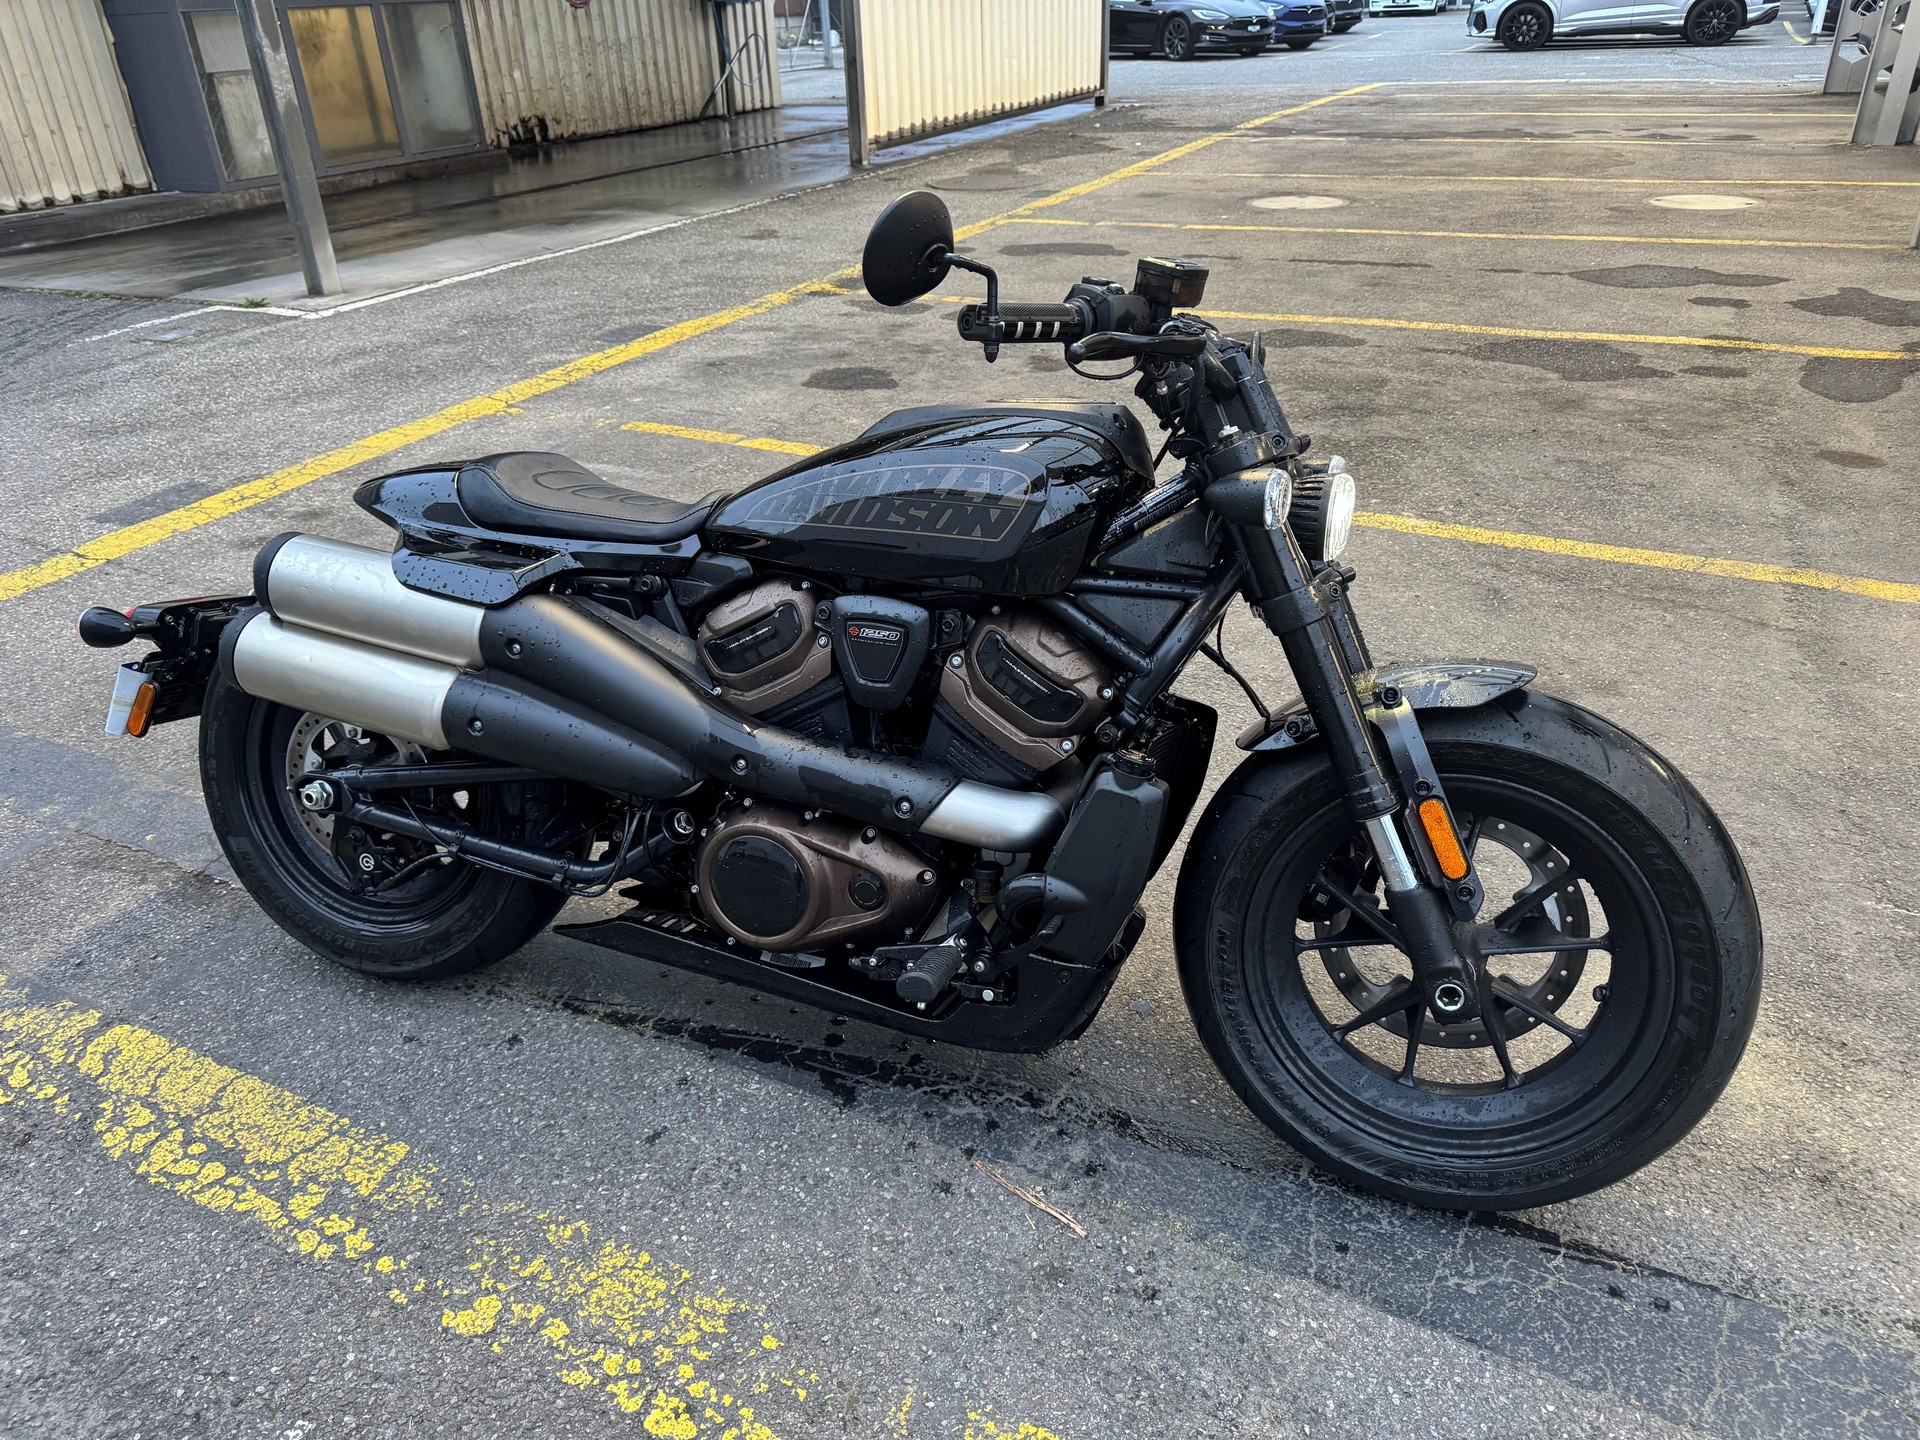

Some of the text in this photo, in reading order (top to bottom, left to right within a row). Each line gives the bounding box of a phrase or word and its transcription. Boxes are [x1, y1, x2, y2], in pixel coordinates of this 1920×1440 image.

[810, 465, 1029, 510] HARLEY
[755, 488, 1016, 538] DAVIDSON
[860, 627, 900, 641] 1250
